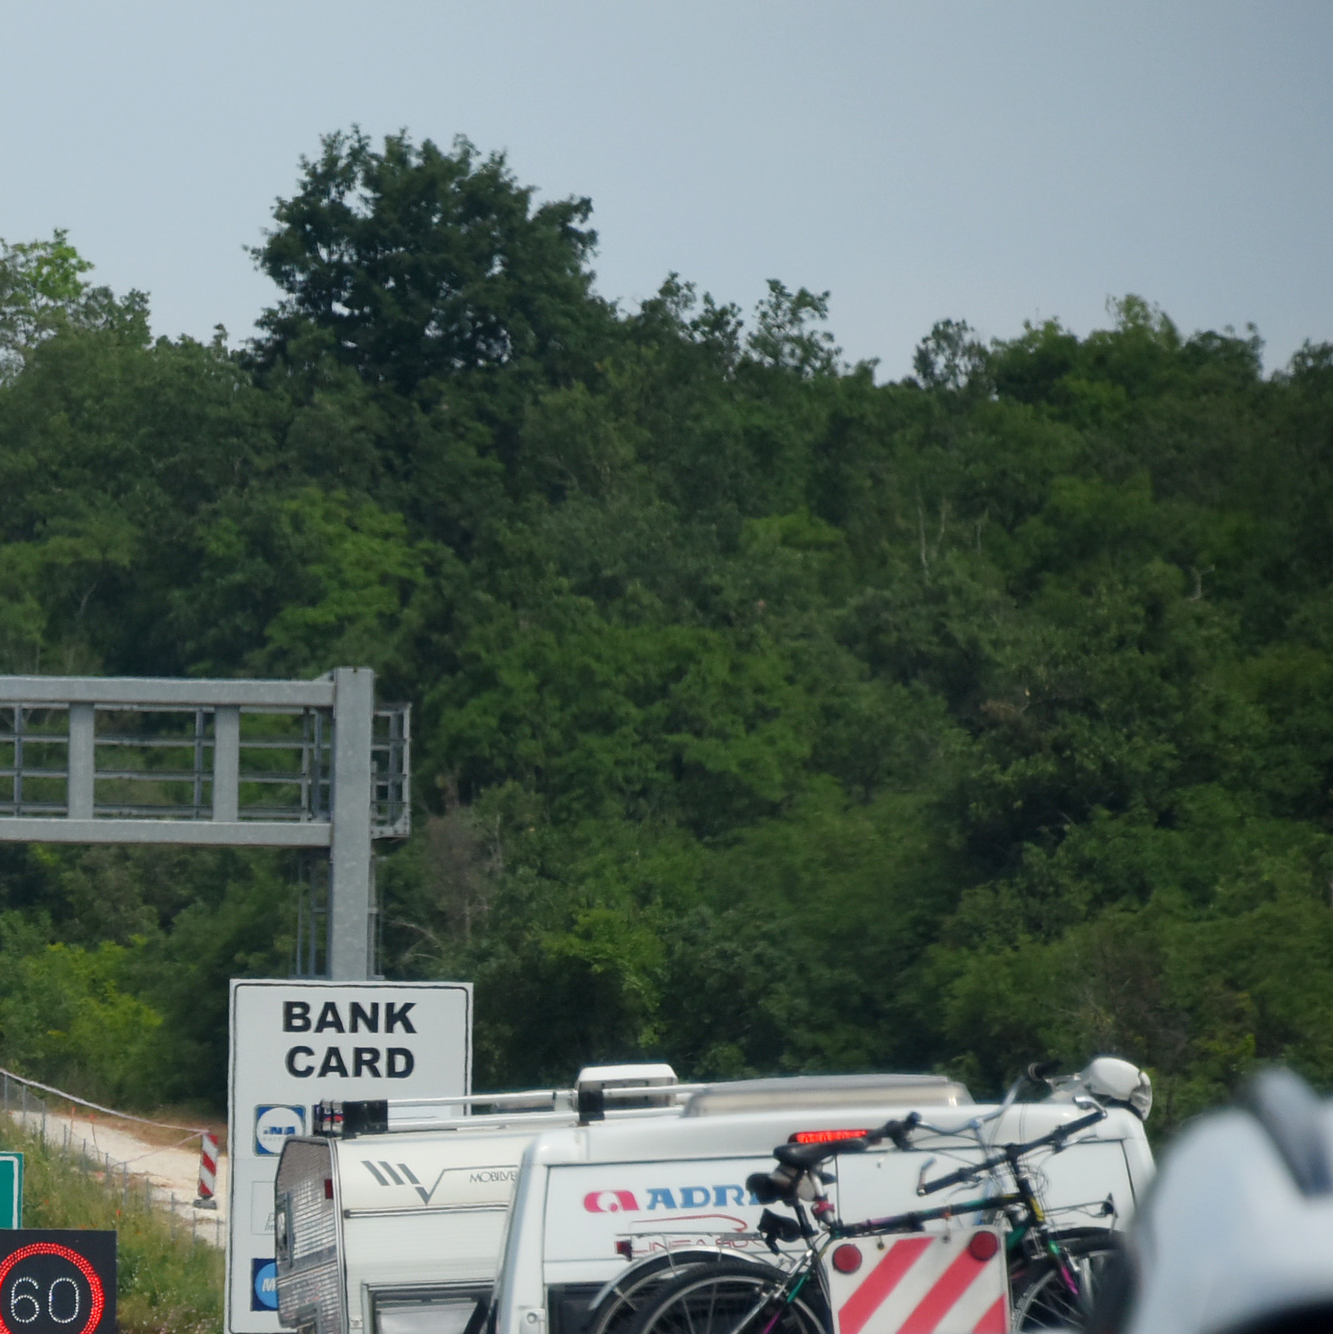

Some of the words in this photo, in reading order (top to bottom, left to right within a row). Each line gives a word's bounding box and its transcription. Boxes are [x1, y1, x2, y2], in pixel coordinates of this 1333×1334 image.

[283, 1001, 416, 1034] BANK
[285, 1046, 415, 1078] CARD
[10, 1276, 80, 1324] 60
